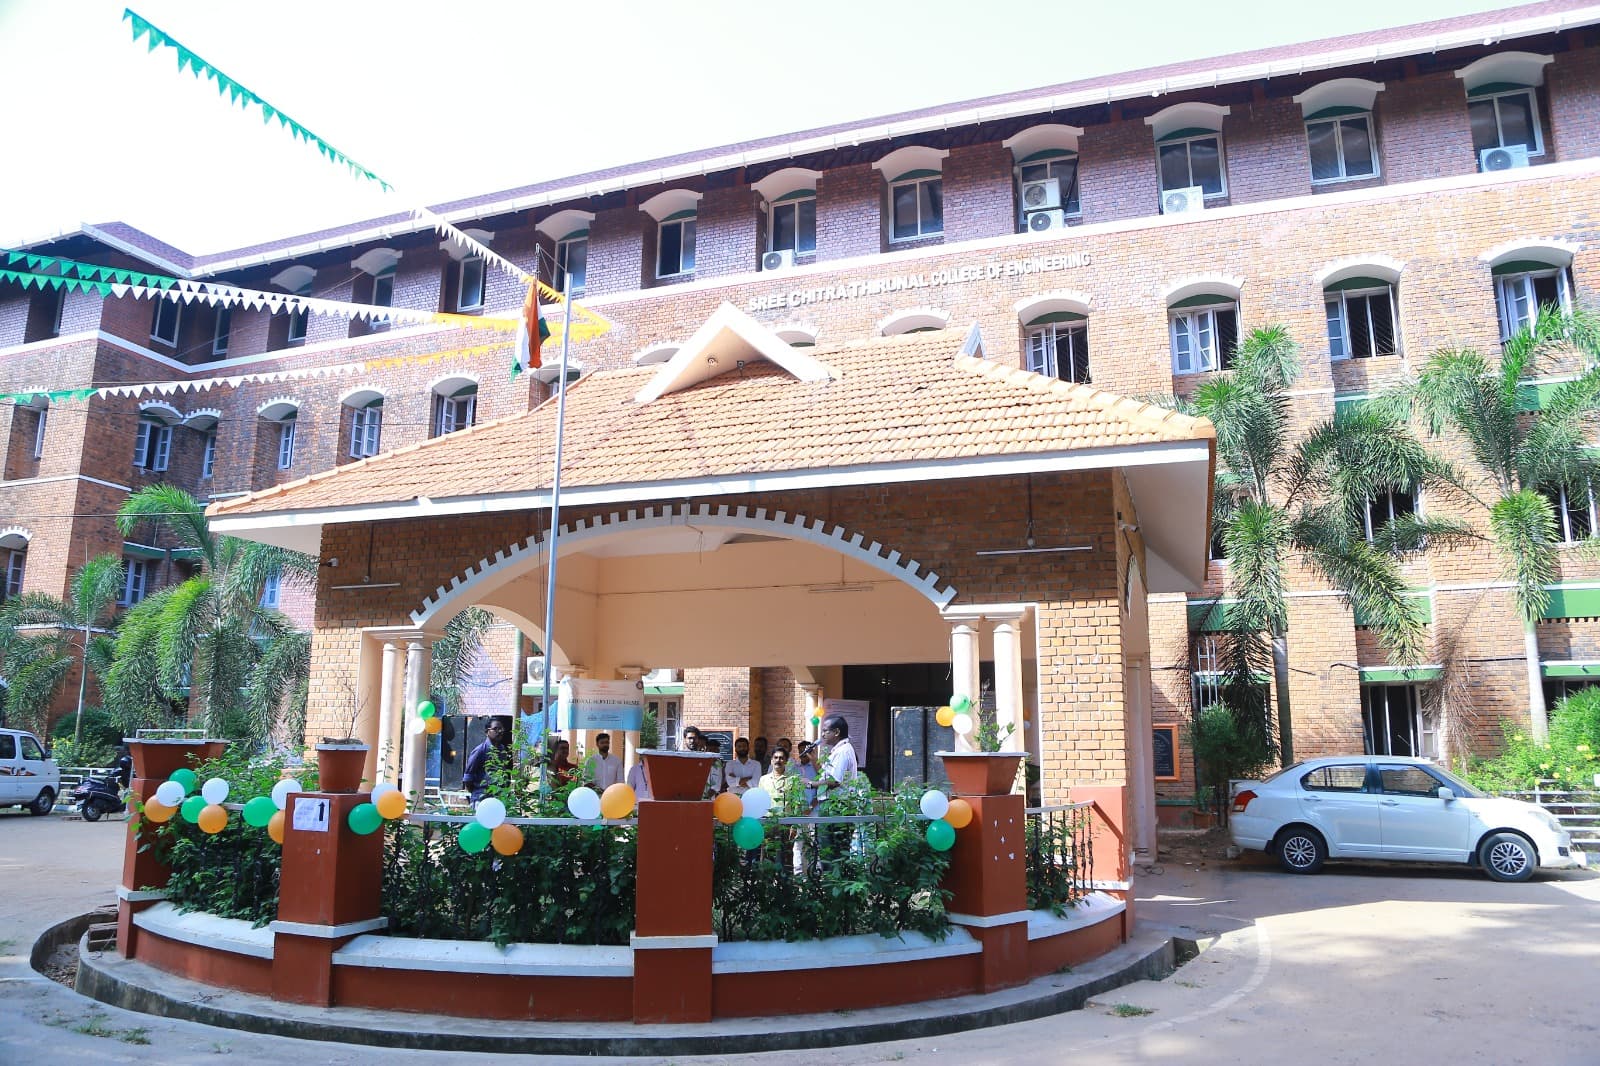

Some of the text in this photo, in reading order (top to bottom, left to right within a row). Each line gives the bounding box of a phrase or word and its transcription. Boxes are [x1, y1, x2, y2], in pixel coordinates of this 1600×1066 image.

[749, 253, 1092, 311] SREE CHITRA THIRUNAL COLLEGE OF ENGINEERING
